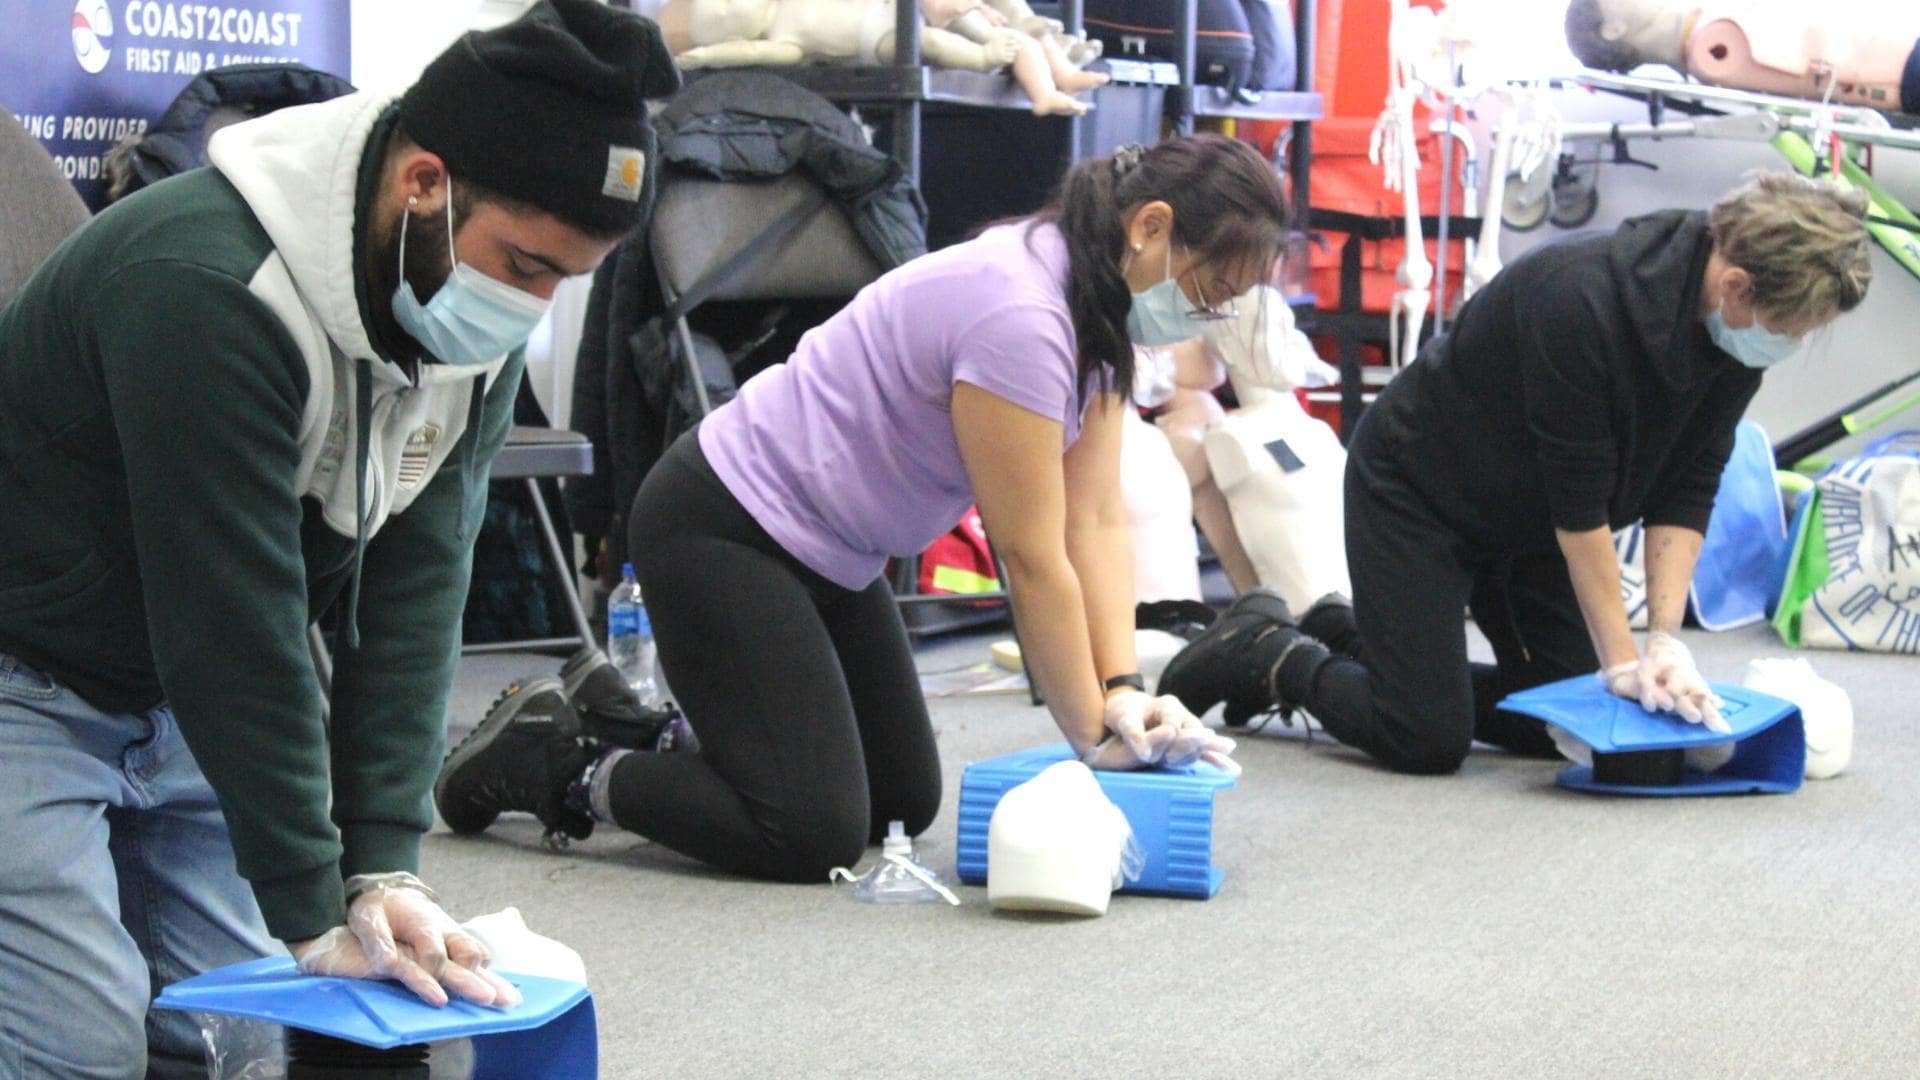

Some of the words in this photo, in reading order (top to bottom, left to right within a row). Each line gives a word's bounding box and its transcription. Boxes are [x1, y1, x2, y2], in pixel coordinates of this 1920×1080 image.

[125, 0, 302, 47] COAST2COAST
[126, 47, 171, 73] FIRST
[173, 51, 201, 75] AID
[13, 114, 56, 140] ING
[62, 116, 148, 141] PROVIDER
